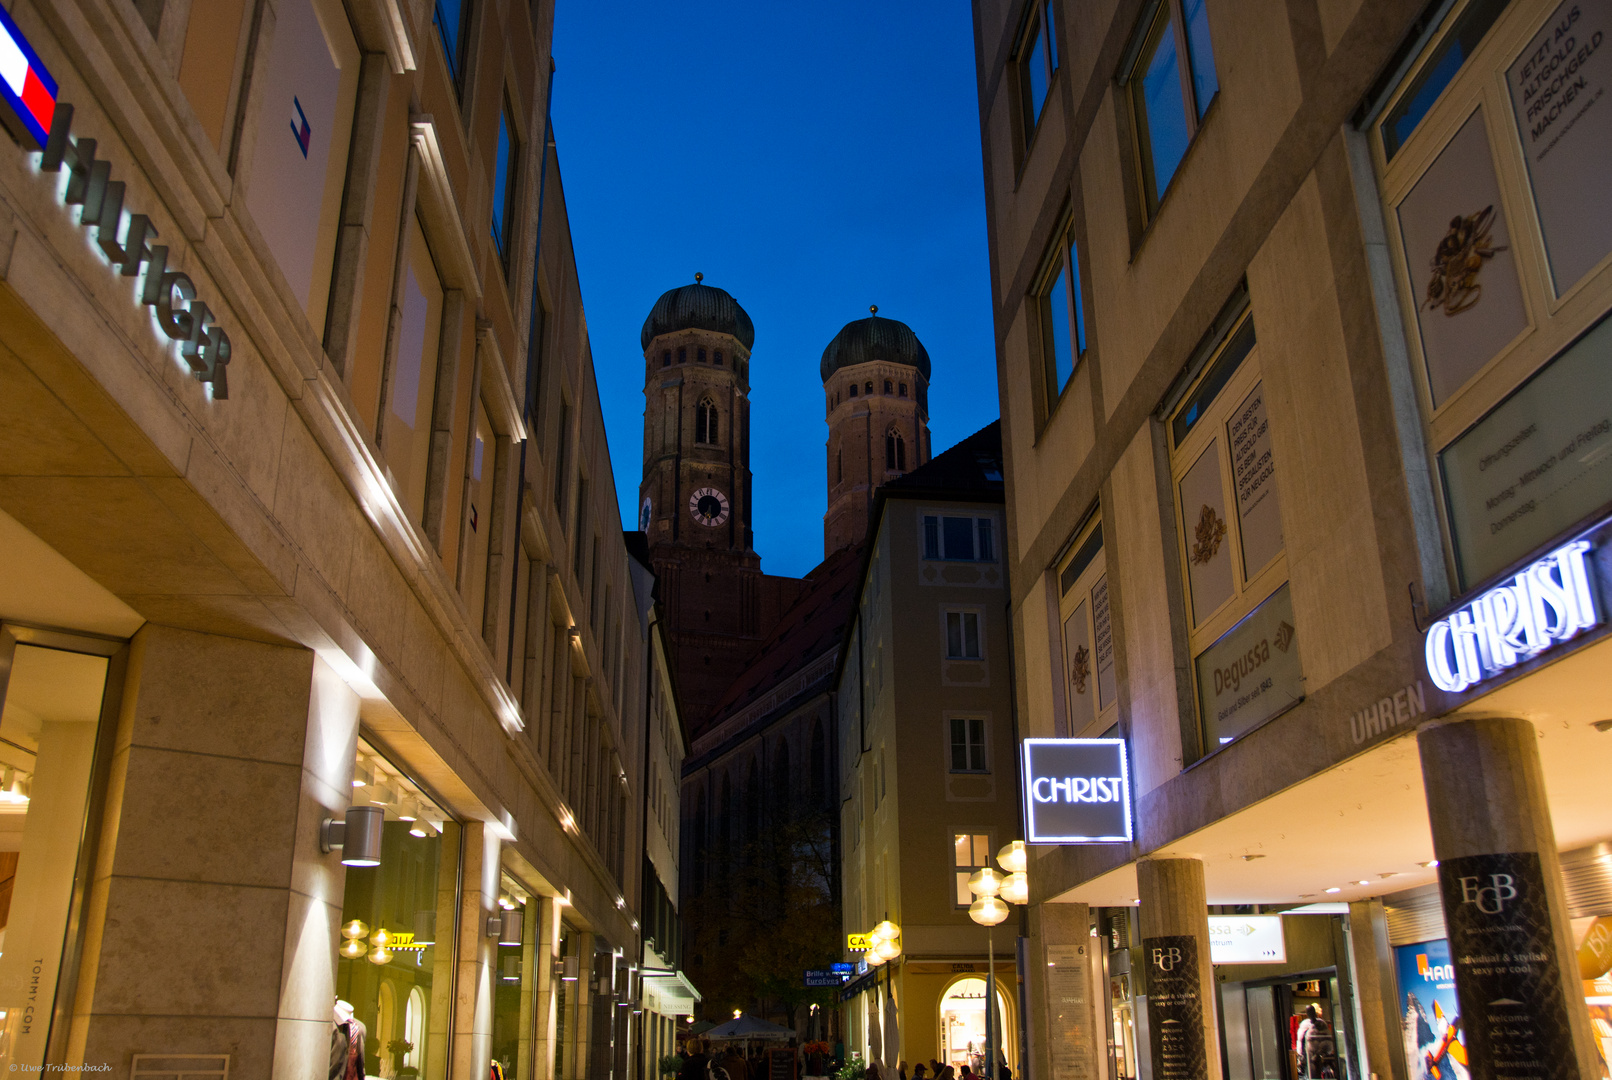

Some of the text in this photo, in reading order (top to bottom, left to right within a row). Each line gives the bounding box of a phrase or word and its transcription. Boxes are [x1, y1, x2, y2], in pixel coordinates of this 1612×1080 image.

[1520, 5, 1581, 86] JETZT AUS
[1523, 36, 1576, 105] ALTGOLD
[1526, 30, 1603, 124] FRISCHGELD
[1531, 75, 1588, 142] MACHEN.
[41, 102, 232, 400] HILFIGER
[1243, 396, 1262, 423] BESTEN
[1236, 434, 1256, 463] ALTGOLD
[1558, 440, 1576, 460] und
[1238, 448, 1272, 490] SPEZIALISTEN
[1425, 540, 1598, 693] CHRIST
[1214, 638, 1270, 697] Degussa
[1218, 709, 1228, 722] Gold
[1229, 701, 1238, 714] und
[1238, 694, 1250, 708] Silber
[1251, 686, 1260, 700] seit
[1350, 680, 1427, 745] UHREN
[1032, 776, 1122, 803] CHRIST
[1078, 946, 1084, 955] 6
[1472, 964, 1532, 976] sexy or cool
[1513, 952, 1548, 965] stylish
[1423, 964, 1454, 982] HAN
[22, 958, 43, 1034] TOMMY.COM
[1487, 1015, 1530, 1023] Welcome
